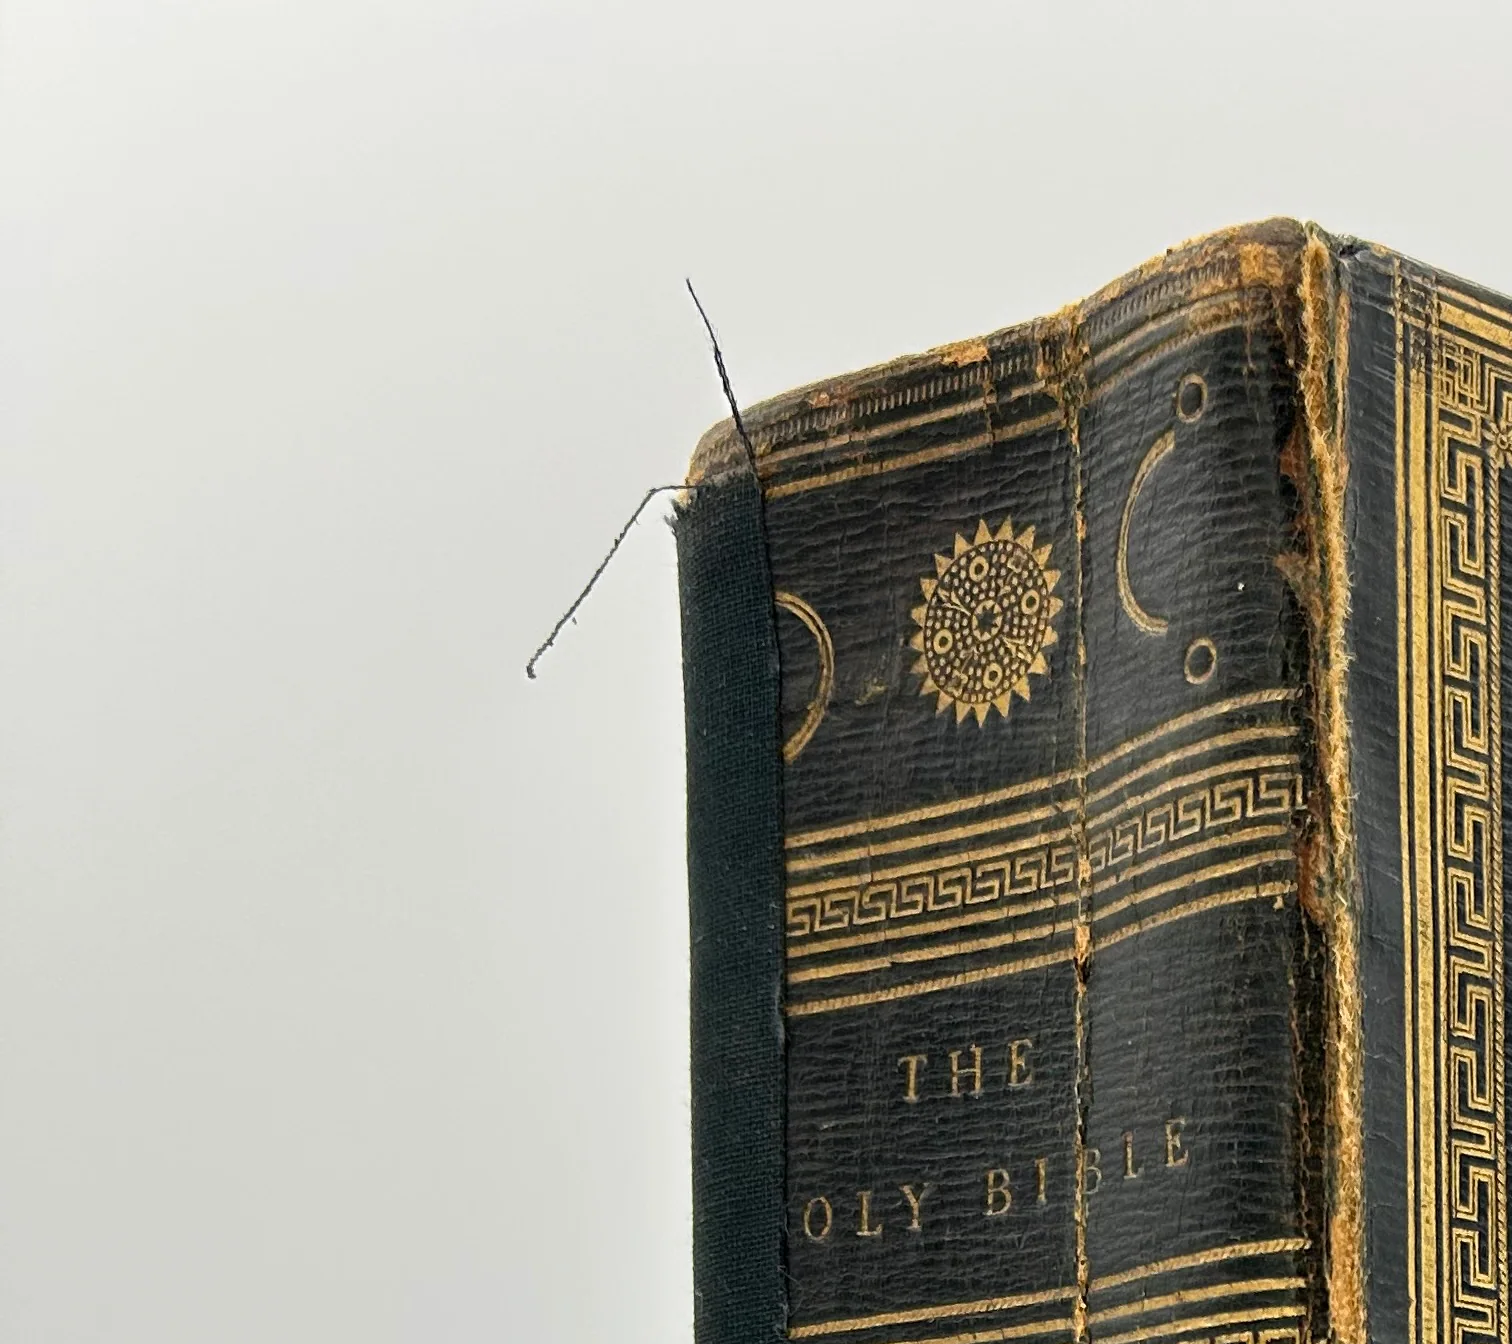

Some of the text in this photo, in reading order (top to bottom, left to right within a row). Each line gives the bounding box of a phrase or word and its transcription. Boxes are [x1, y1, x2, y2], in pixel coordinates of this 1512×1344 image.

[899, 1038, 1036, 1101] THE
[803, 1117, 1190, 1241] OLY BIBLE
